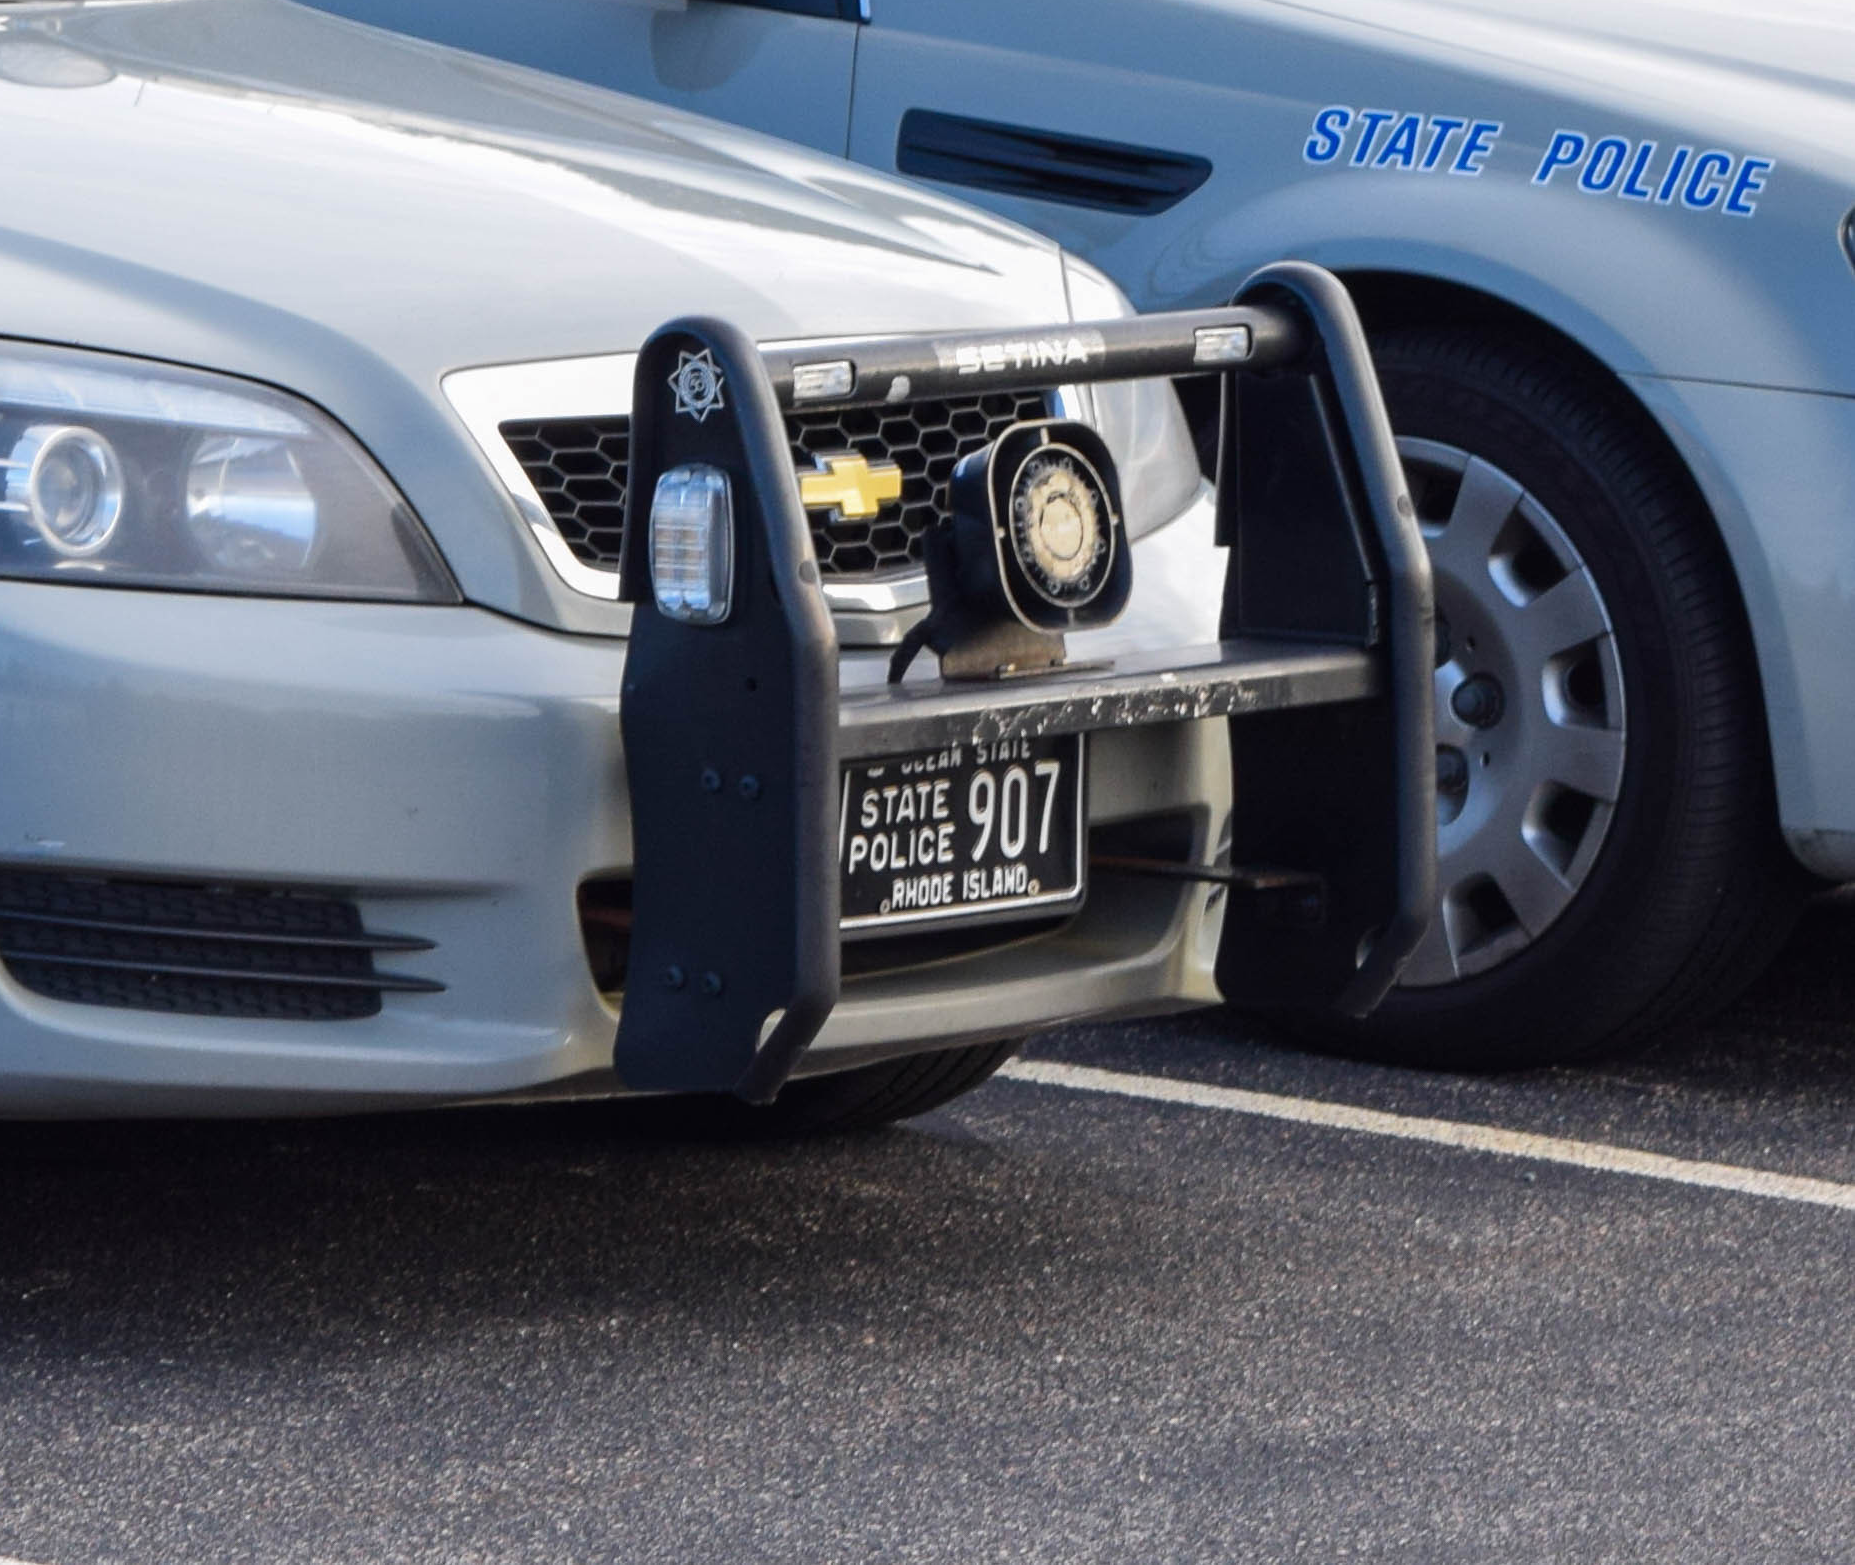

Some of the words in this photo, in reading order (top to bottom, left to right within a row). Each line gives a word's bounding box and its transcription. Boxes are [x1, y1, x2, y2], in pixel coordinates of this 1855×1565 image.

[1303, 105, 1506, 176] STATE
[1531, 128, 1776, 218] POLICE
[956, 338, 1088, 375] SETINA
[861, 779, 951, 828] STATE
[969, 759, 1060, 862] 907
[849, 823, 955, 875] POLICE
[892, 872, 954, 909] RHODE
[963, 864, 1028, 901] ISLAND
